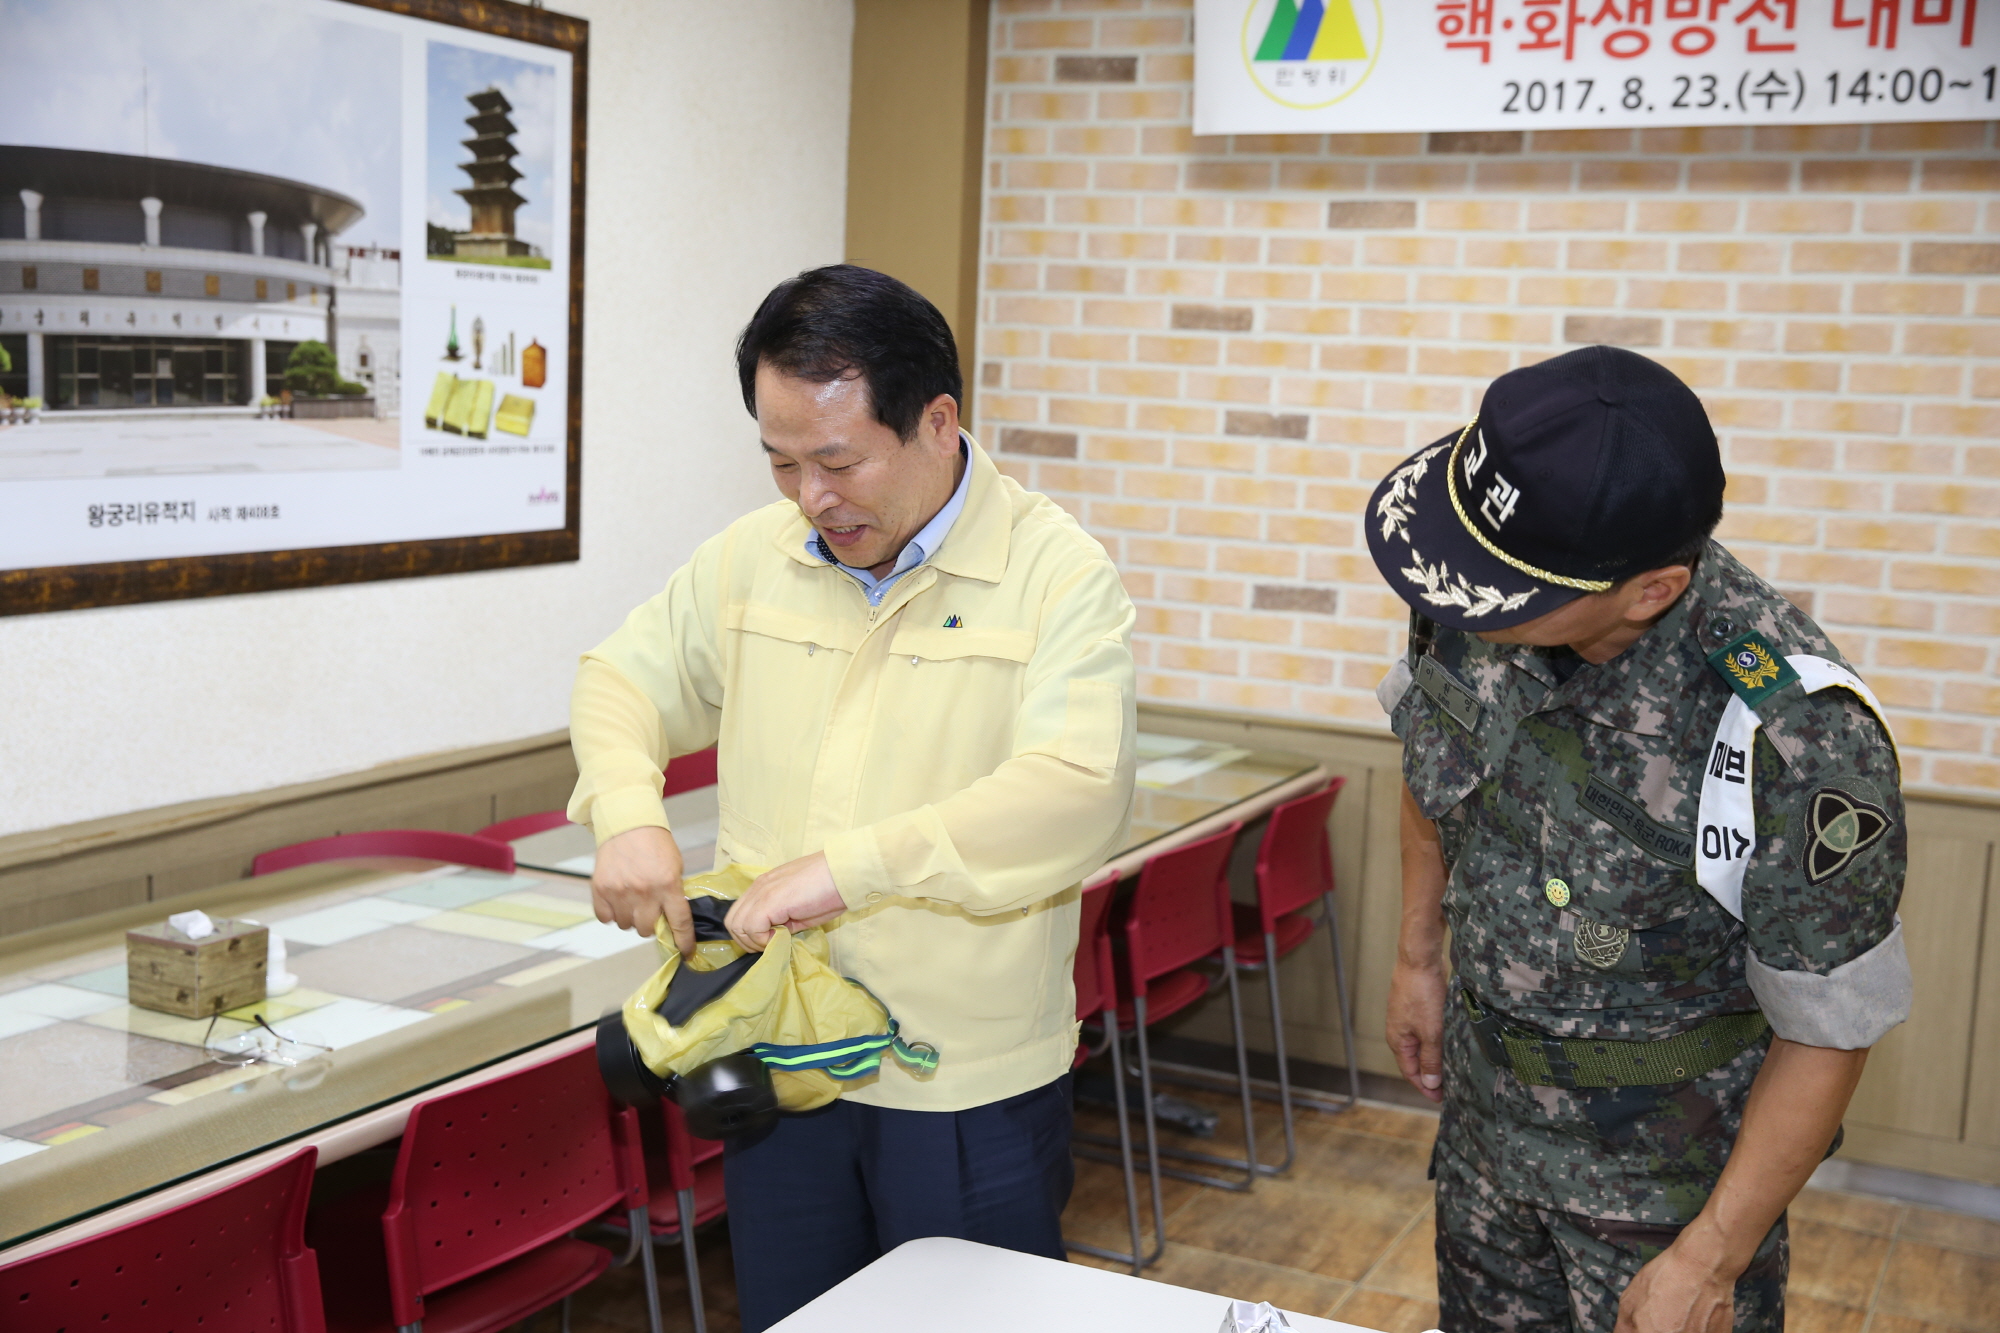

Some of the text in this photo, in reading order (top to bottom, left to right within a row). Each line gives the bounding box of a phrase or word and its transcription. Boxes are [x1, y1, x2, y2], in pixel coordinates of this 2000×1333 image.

[1502, 80, 1605, 113] 2017.
[1621, 77, 1653, 110] 8.
[1463, 427, 1521, 532] 교관
[88, 500, 196, 528] 왕궁리유적지
[1584, 785, 1692, 859] 대한민국 육군 ROKA
